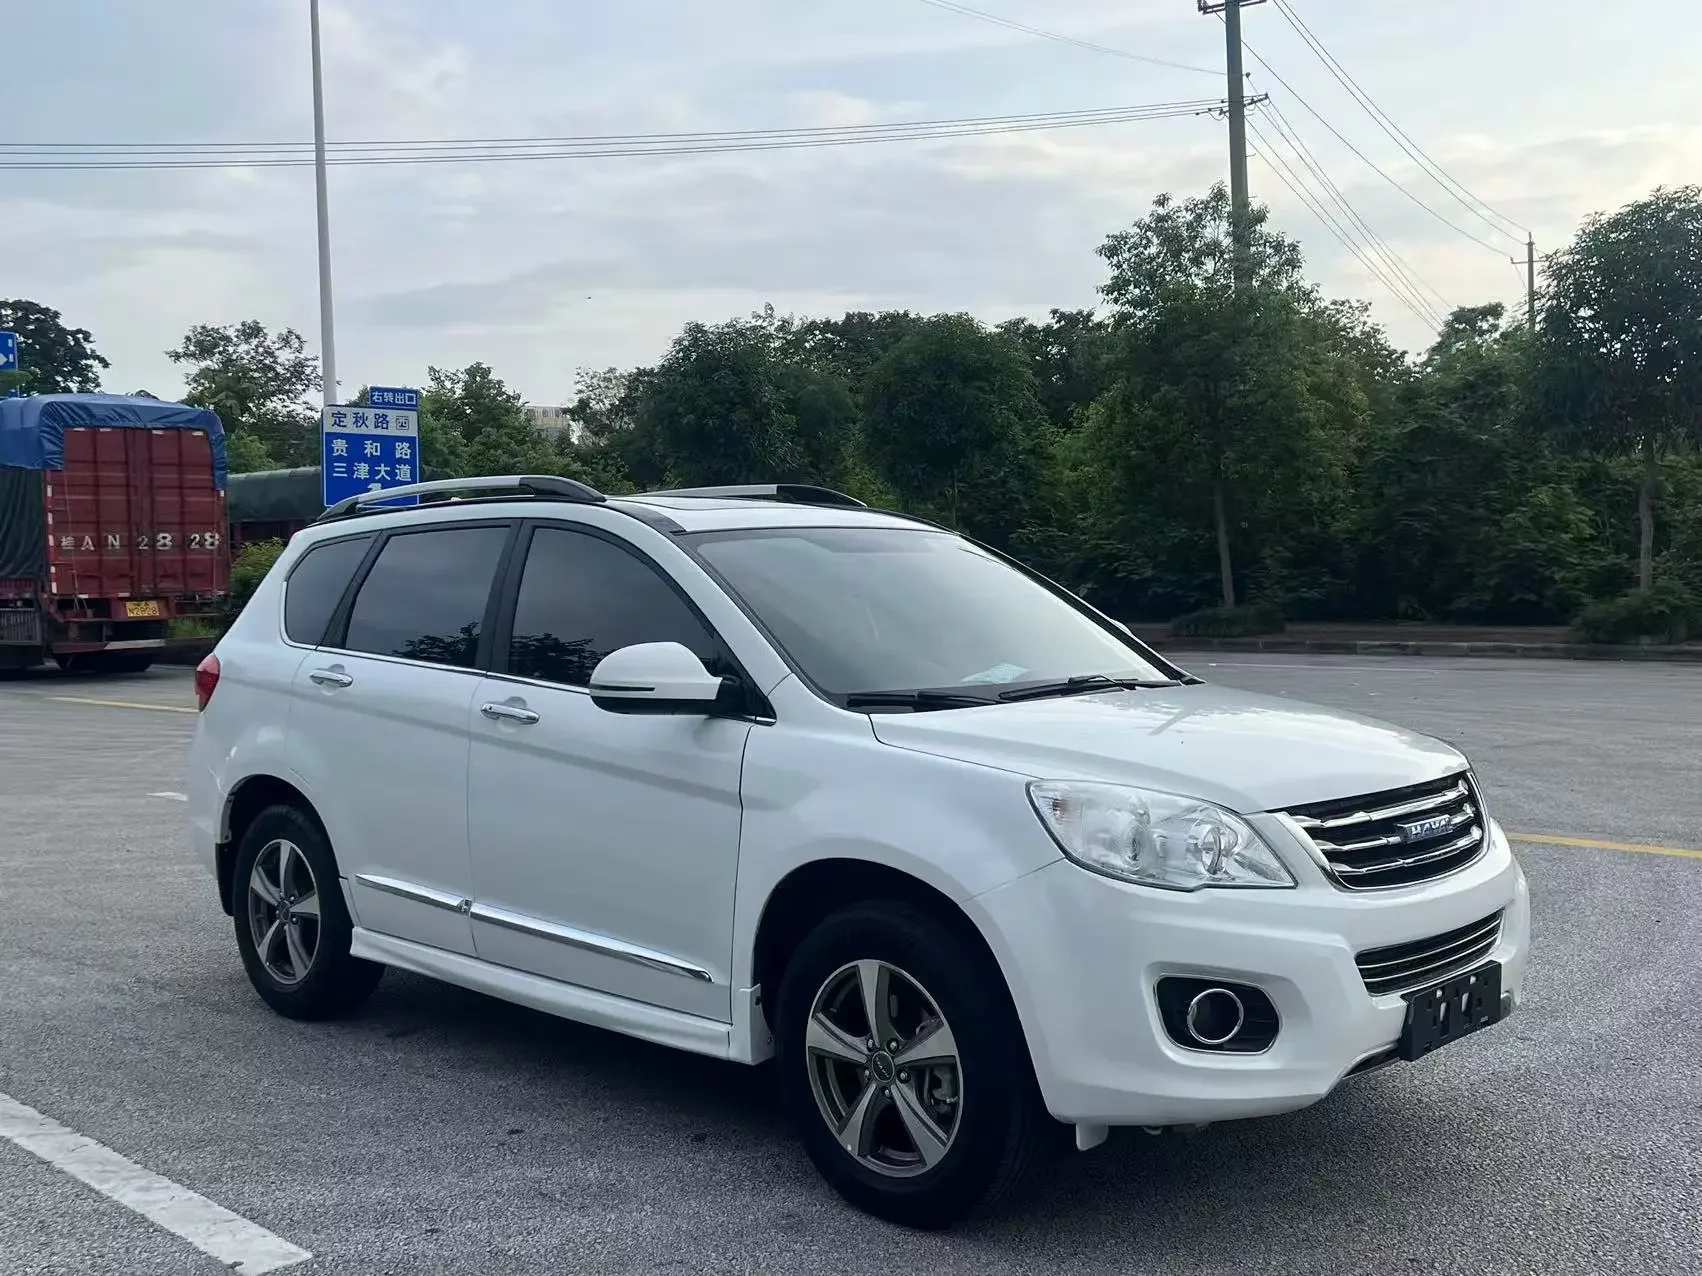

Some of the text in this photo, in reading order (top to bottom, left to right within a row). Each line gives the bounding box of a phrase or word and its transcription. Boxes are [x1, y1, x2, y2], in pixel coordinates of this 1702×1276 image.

[372, 391, 416, 405] 右转出口
[332, 462, 412, 481] 三津大道
